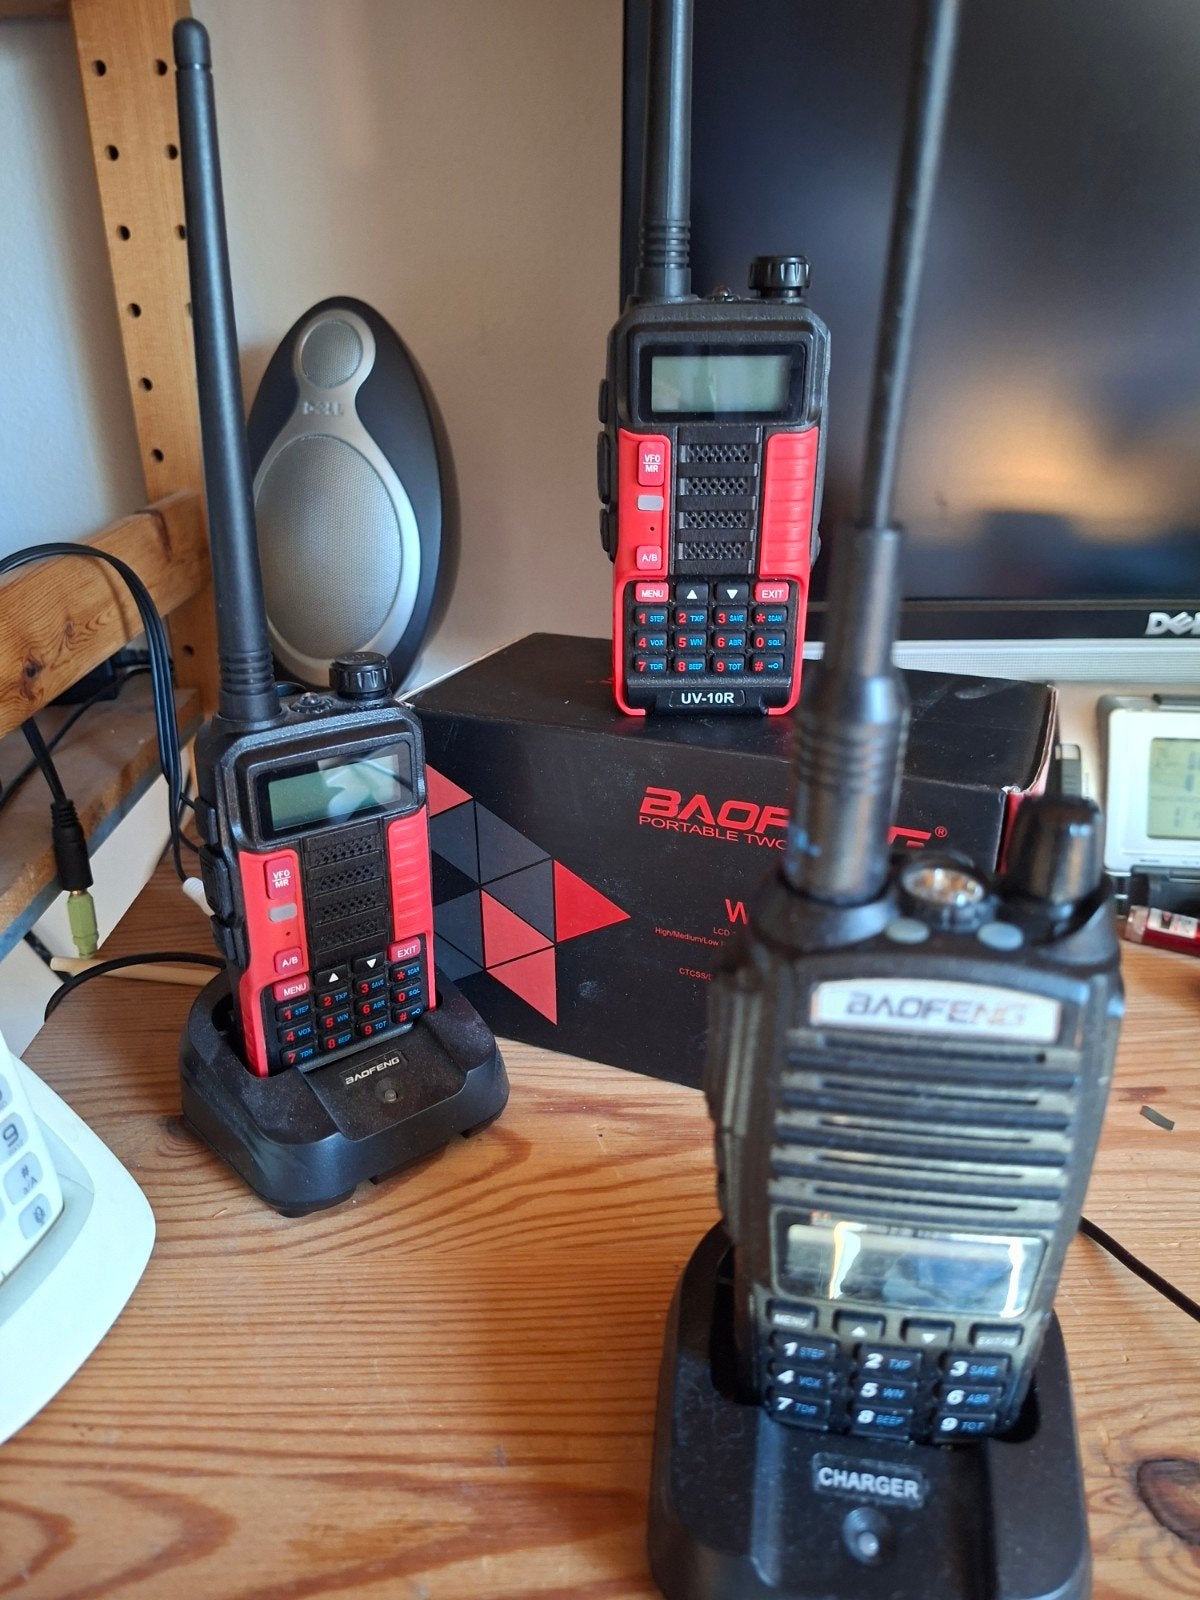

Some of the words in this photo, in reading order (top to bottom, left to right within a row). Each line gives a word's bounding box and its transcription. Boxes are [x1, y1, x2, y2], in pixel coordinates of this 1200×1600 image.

[644, 454, 661, 463] VFO
[645, 464, 659, 473] MR
[642, 553, 658, 562] A/B
[641, 589, 664, 598] MENU
[761, 589, 784, 598] EXIT
[639, 613, 646, 624] 1
[678, 613, 687, 624] 2
[718, 613, 726, 624] 3
[729, 614, 744, 622] SAVE
[638, 637, 647, 648] 4
[678, 637, 687, 648] 5
[717, 637, 725, 648] 6
[755, 637, 764, 648] 0
[638, 661, 646, 672] 7
[677, 661, 686, 672] 8
[716, 661, 725, 672] 9
[754, 661, 764, 672] #
[681, 692, 735, 704] UV-10R
[639, 815, 739, 842] PORTABLE
[272, 869, 291, 880] VFO
[275, 878, 290, 889] MR
[654, 926, 719, 946] High/Medium/Low
[712, 926, 730, 937] LCD
[397, 945, 417, 958] EXIT
[281, 955, 299, 968] A/B
[407, 966, 420, 976] SCAN
[283, 982, 307, 997] MENU
[361, 983, 369, 994] 3
[371, 979, 384, 989] SAVE
[324, 996, 332, 1007] 2
[335, 991, 348, 1001] TXP
[398, 992, 406, 1003] 0
[408, 988, 421, 996] SQL
[284, 1009, 292, 1020] 1
[294, 1005, 309, 1015] STEP
[362, 1005, 371, 1015] 6
[373, 1000, 385, 1010] ABR
[847, 991, 1027, 1026] BAOFENG
[326, 1017, 334, 1028] 5
[400, 1012, 407, 1022] #
[286, 1031, 295, 1042] 4
[298, 1027, 312, 1036] VOX
[364, 1024, 372, 1035] 9
[375, 1020, 387, 1030] TOT
[328, 1038, 336, 1049] 8
[338, 1033, 351, 1044] BEEP
[288, 1053, 296, 1064] 7
[300, 1048, 313, 1058] TDR
[345, 1056, 400, 1085] BAOFENG
[773, 1313, 809, 1329] MENU
[784, 1341, 798, 1357] 1
[799, 1346, 827, 1360] STEP
[863, 1352, 884, 1370] 2
[888, 1358, 912, 1370] TXP
[949, 1360, 969, 1377] 3
[968, 1365, 999, 1378] SAVE
[777, 1369, 795, 1384] 4
[799, 1376, 822, 1389] VOX
[861, 1382, 879, 1398] 5
[946, 1389, 966, 1405] 6
[777, 1396, 794, 1411] 7
[795, 1402, 817, 1414] TDR
[857, 1409, 875, 1424] 8
[875, 1414, 904, 1427] BEEP
[941, 1417, 959, 1432] 9
[961, 1421, 986, 1431] TOT
[818, 1466, 920, 1499] CHARGER
